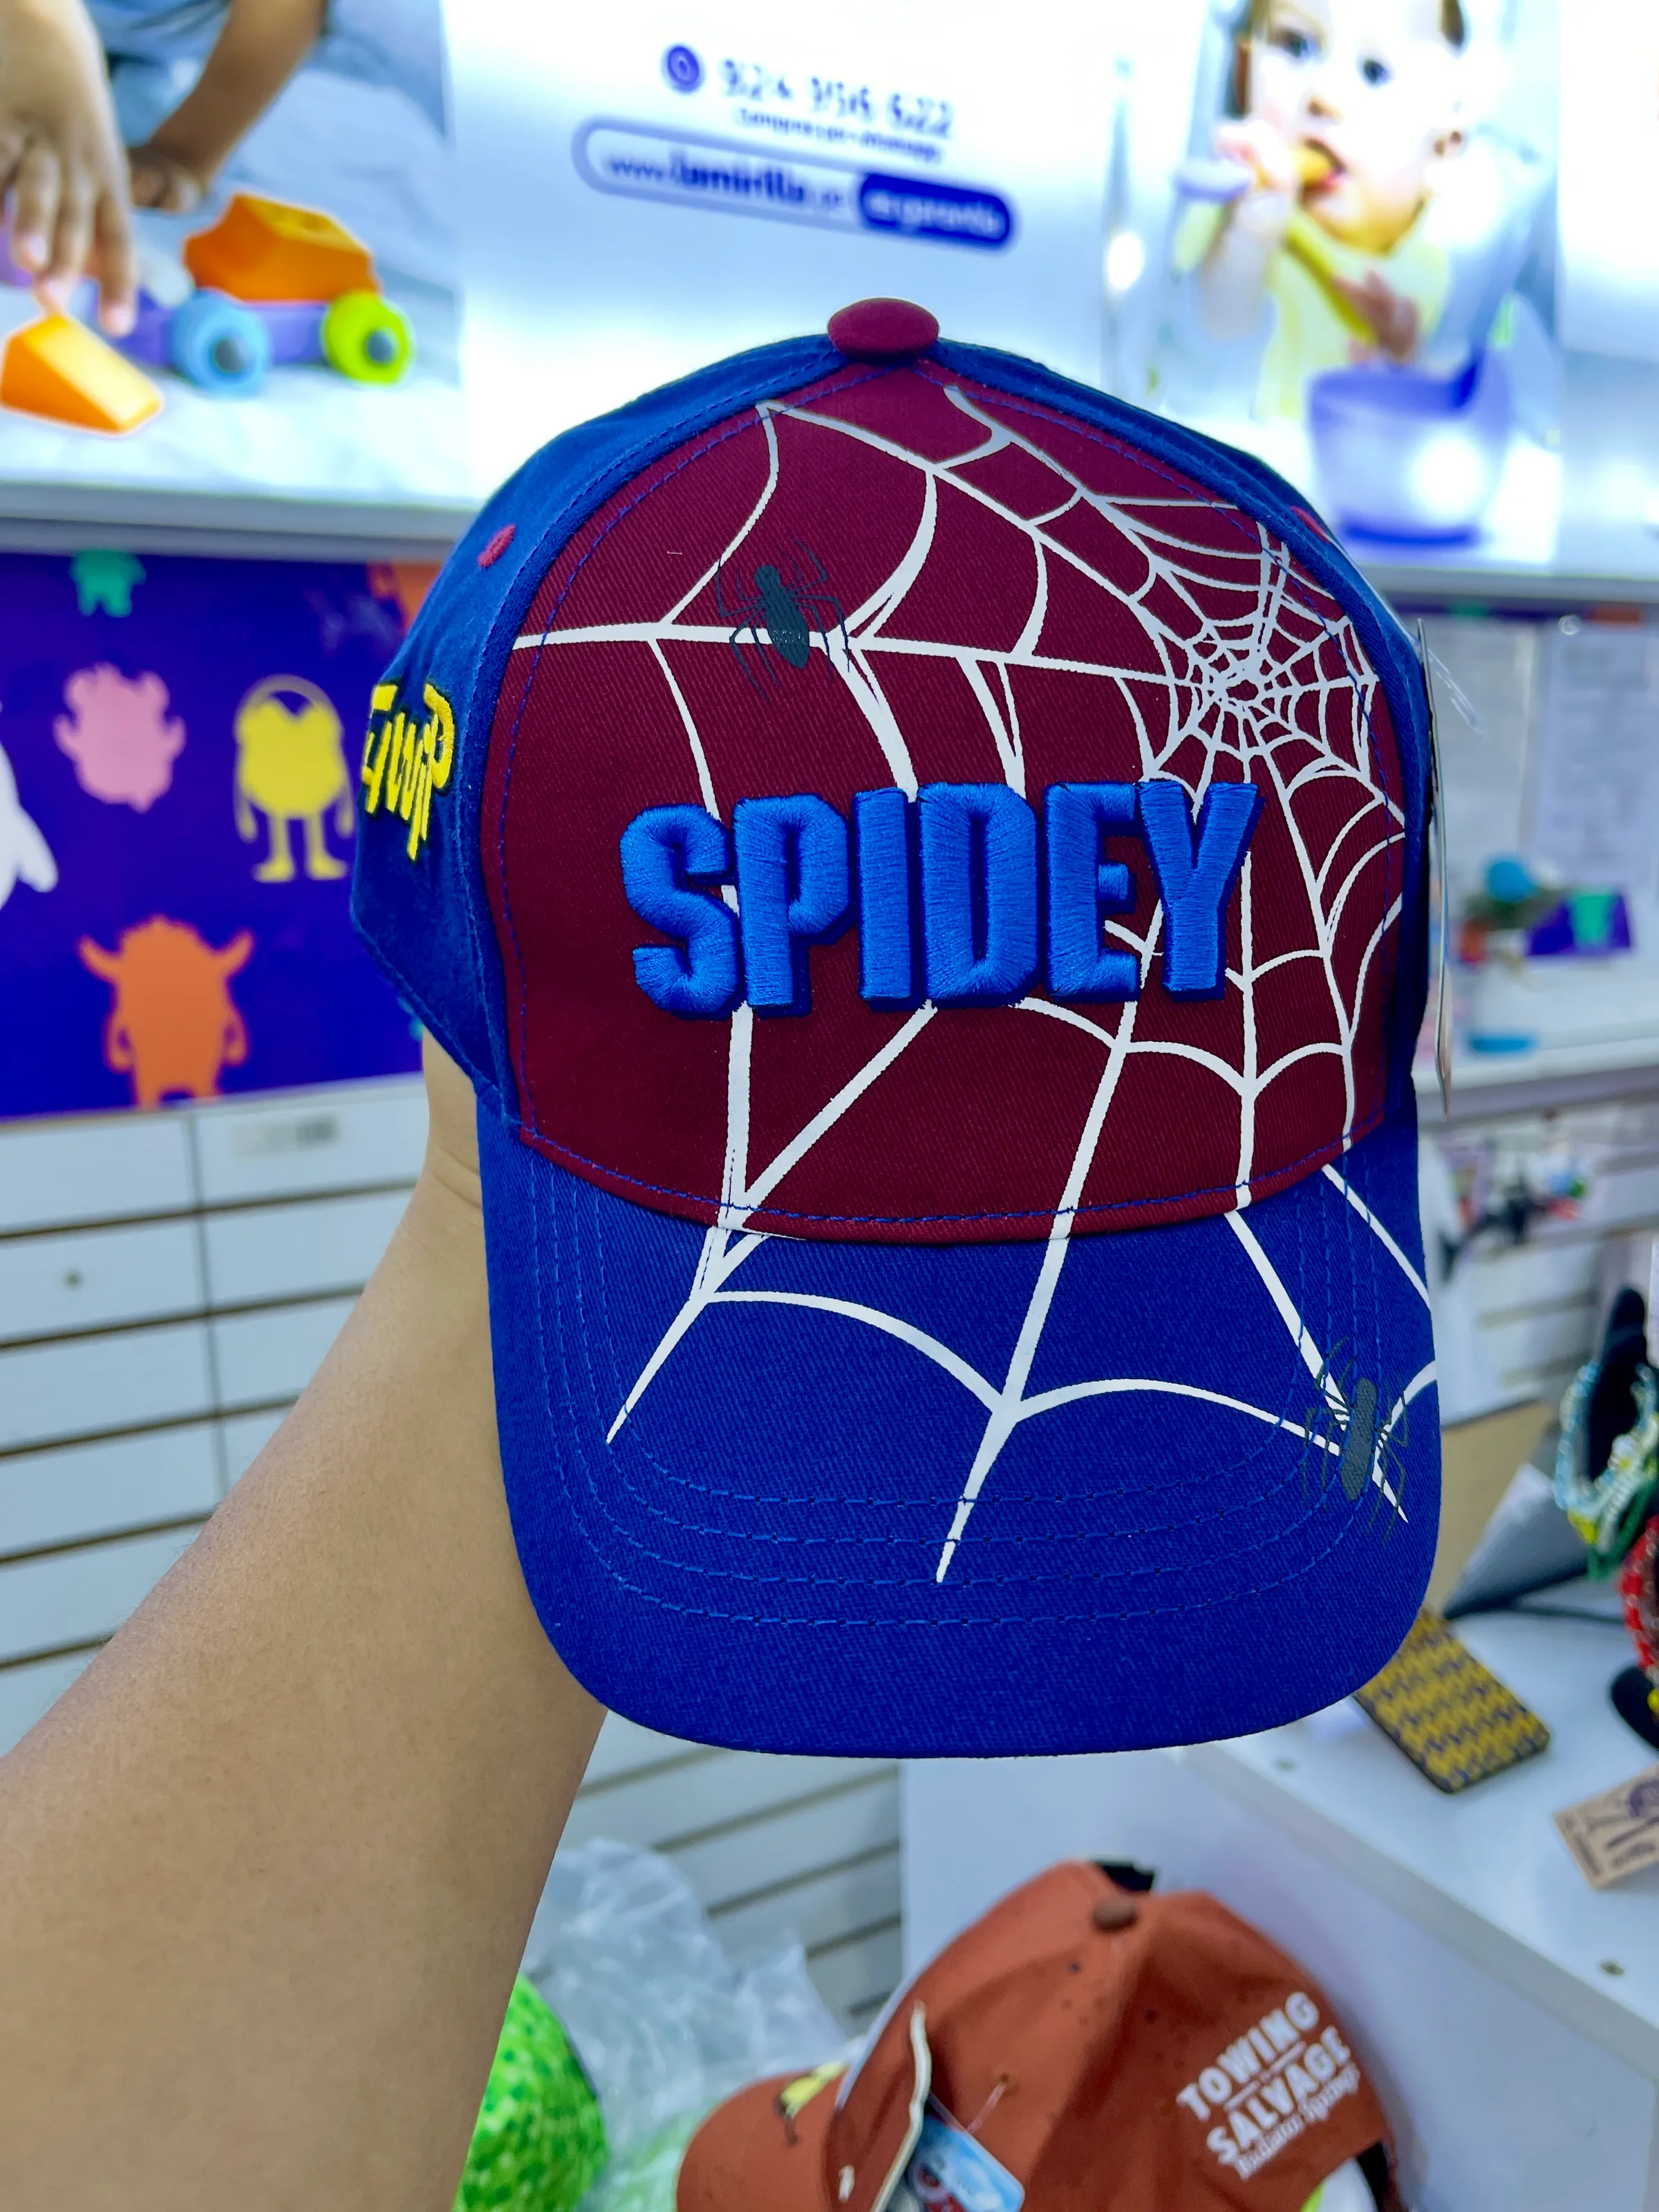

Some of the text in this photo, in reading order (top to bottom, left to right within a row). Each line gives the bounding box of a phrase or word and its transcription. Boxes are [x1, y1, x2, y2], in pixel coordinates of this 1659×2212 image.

[619, 780, 1262, 1018] SPIDEY
[1177, 1991, 1320, 2122] TOWING
[1206, 2025, 1351, 2165] SALVAGE
